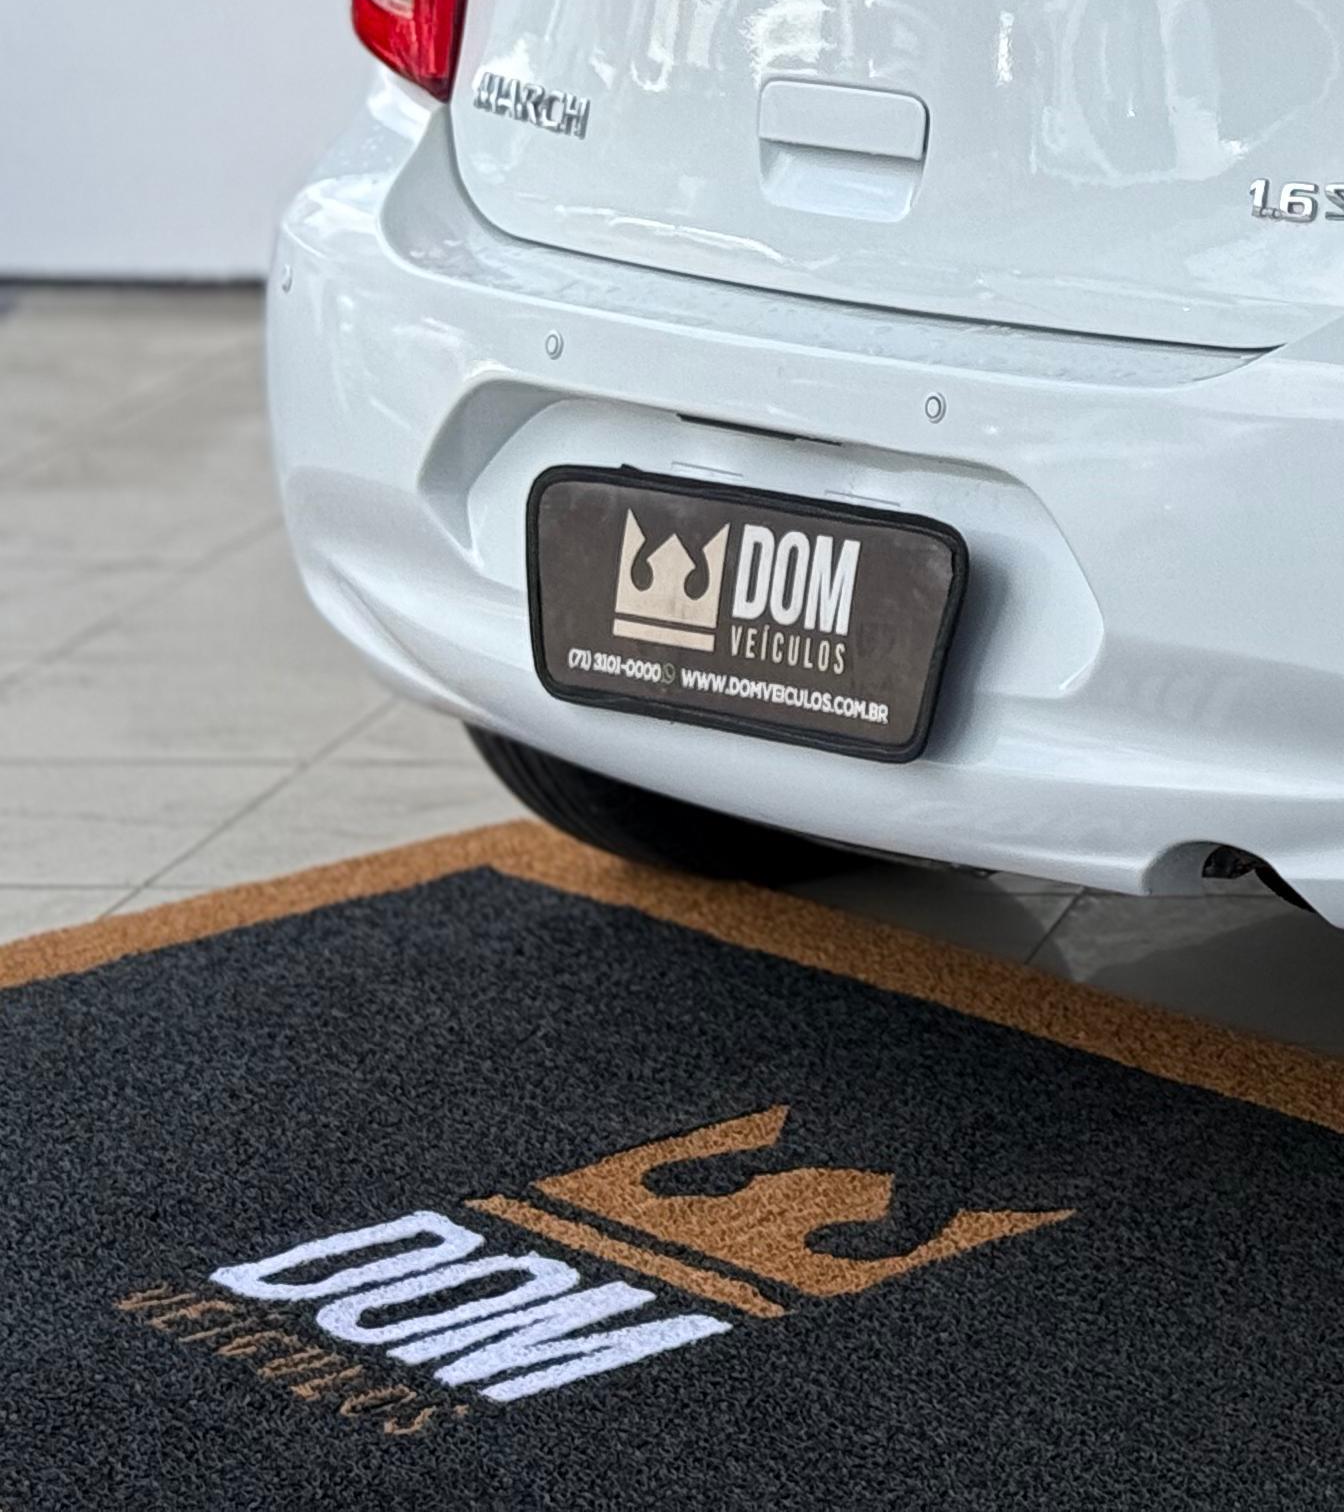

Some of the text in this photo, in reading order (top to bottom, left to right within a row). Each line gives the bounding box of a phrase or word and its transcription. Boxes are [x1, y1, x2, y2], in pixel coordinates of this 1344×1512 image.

[474, 71, 590, 140] MARCH
[732, 523, 861, 637] DOM
[568, 648, 592, 671] (71)
[731, 624, 846, 675] VEÍCULOS
[209, 1210, 733, 1403] DOM
